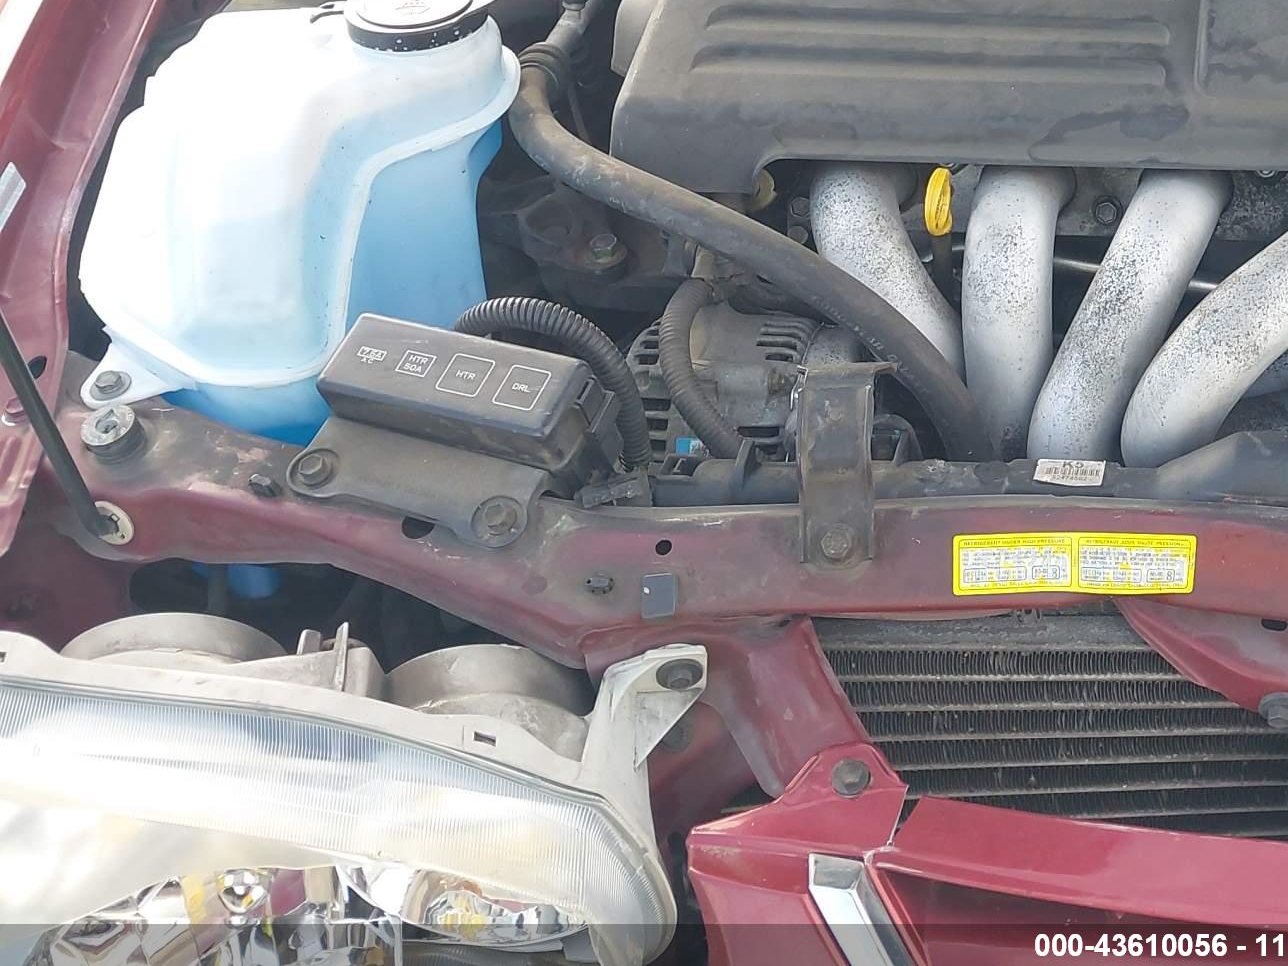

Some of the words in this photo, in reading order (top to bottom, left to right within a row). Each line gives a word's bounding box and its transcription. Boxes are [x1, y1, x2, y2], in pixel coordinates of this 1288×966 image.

[408, 355, 429, 365] HTR
[404, 363, 423, 373] 50A
[456, 370, 476, 381] HTR
[511, 383, 531, 393] DRL
